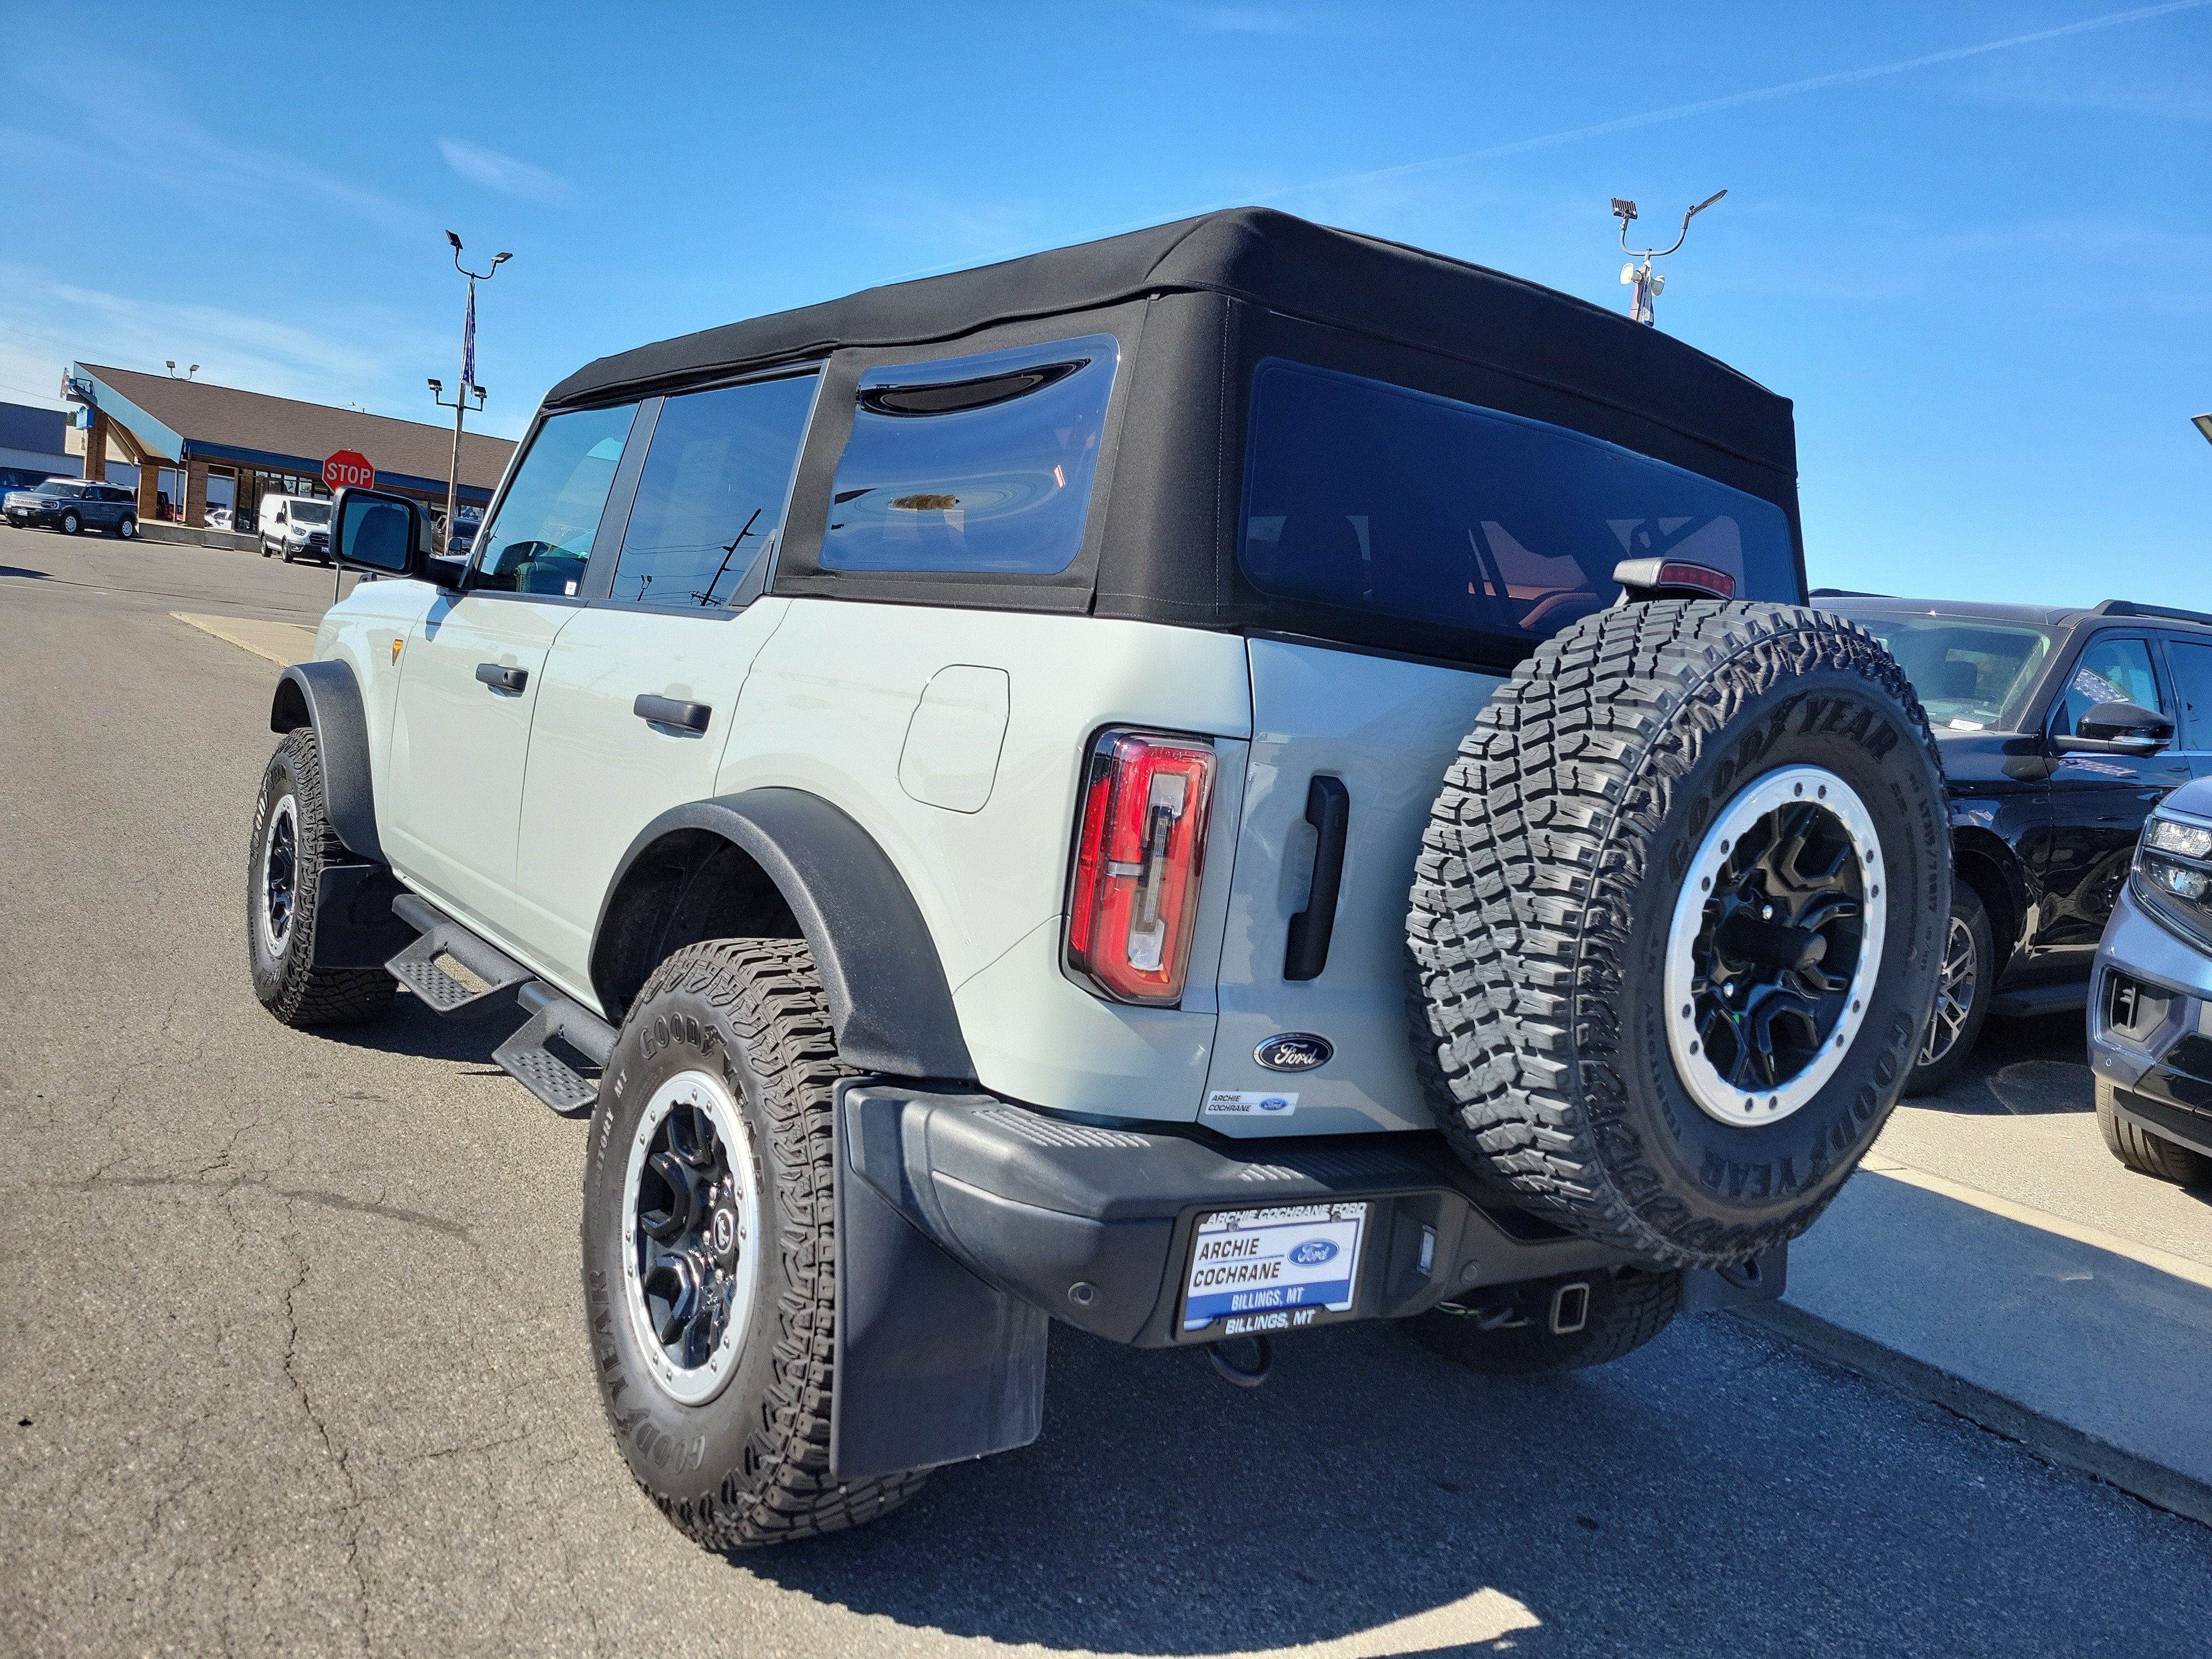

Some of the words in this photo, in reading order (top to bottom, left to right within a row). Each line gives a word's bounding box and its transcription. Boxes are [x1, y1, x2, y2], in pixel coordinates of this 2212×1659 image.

[327, 462, 371, 485] STOP
[1272, 1042, 1317, 1064] Ford
[613, 1069, 629, 1098] MT
[1208, 1104, 1251, 1112] COCHRANE
[1207, 1210, 1258, 1224] ARCHIE
[1258, 1204, 1330, 1220] COCHRANE
[1198, 1238, 1260, 1261] ARCHIE
[1297, 1243, 1330, 1262] Ford
[1193, 1262, 1282, 1288] COCHRANE
[1231, 1289, 1283, 1311] BILLINGS,
[1286, 1287, 1305, 1304] MT
[1225, 1312, 1288, 1335] BILLINGS,
[1293, 1309, 1316, 1325] MT
